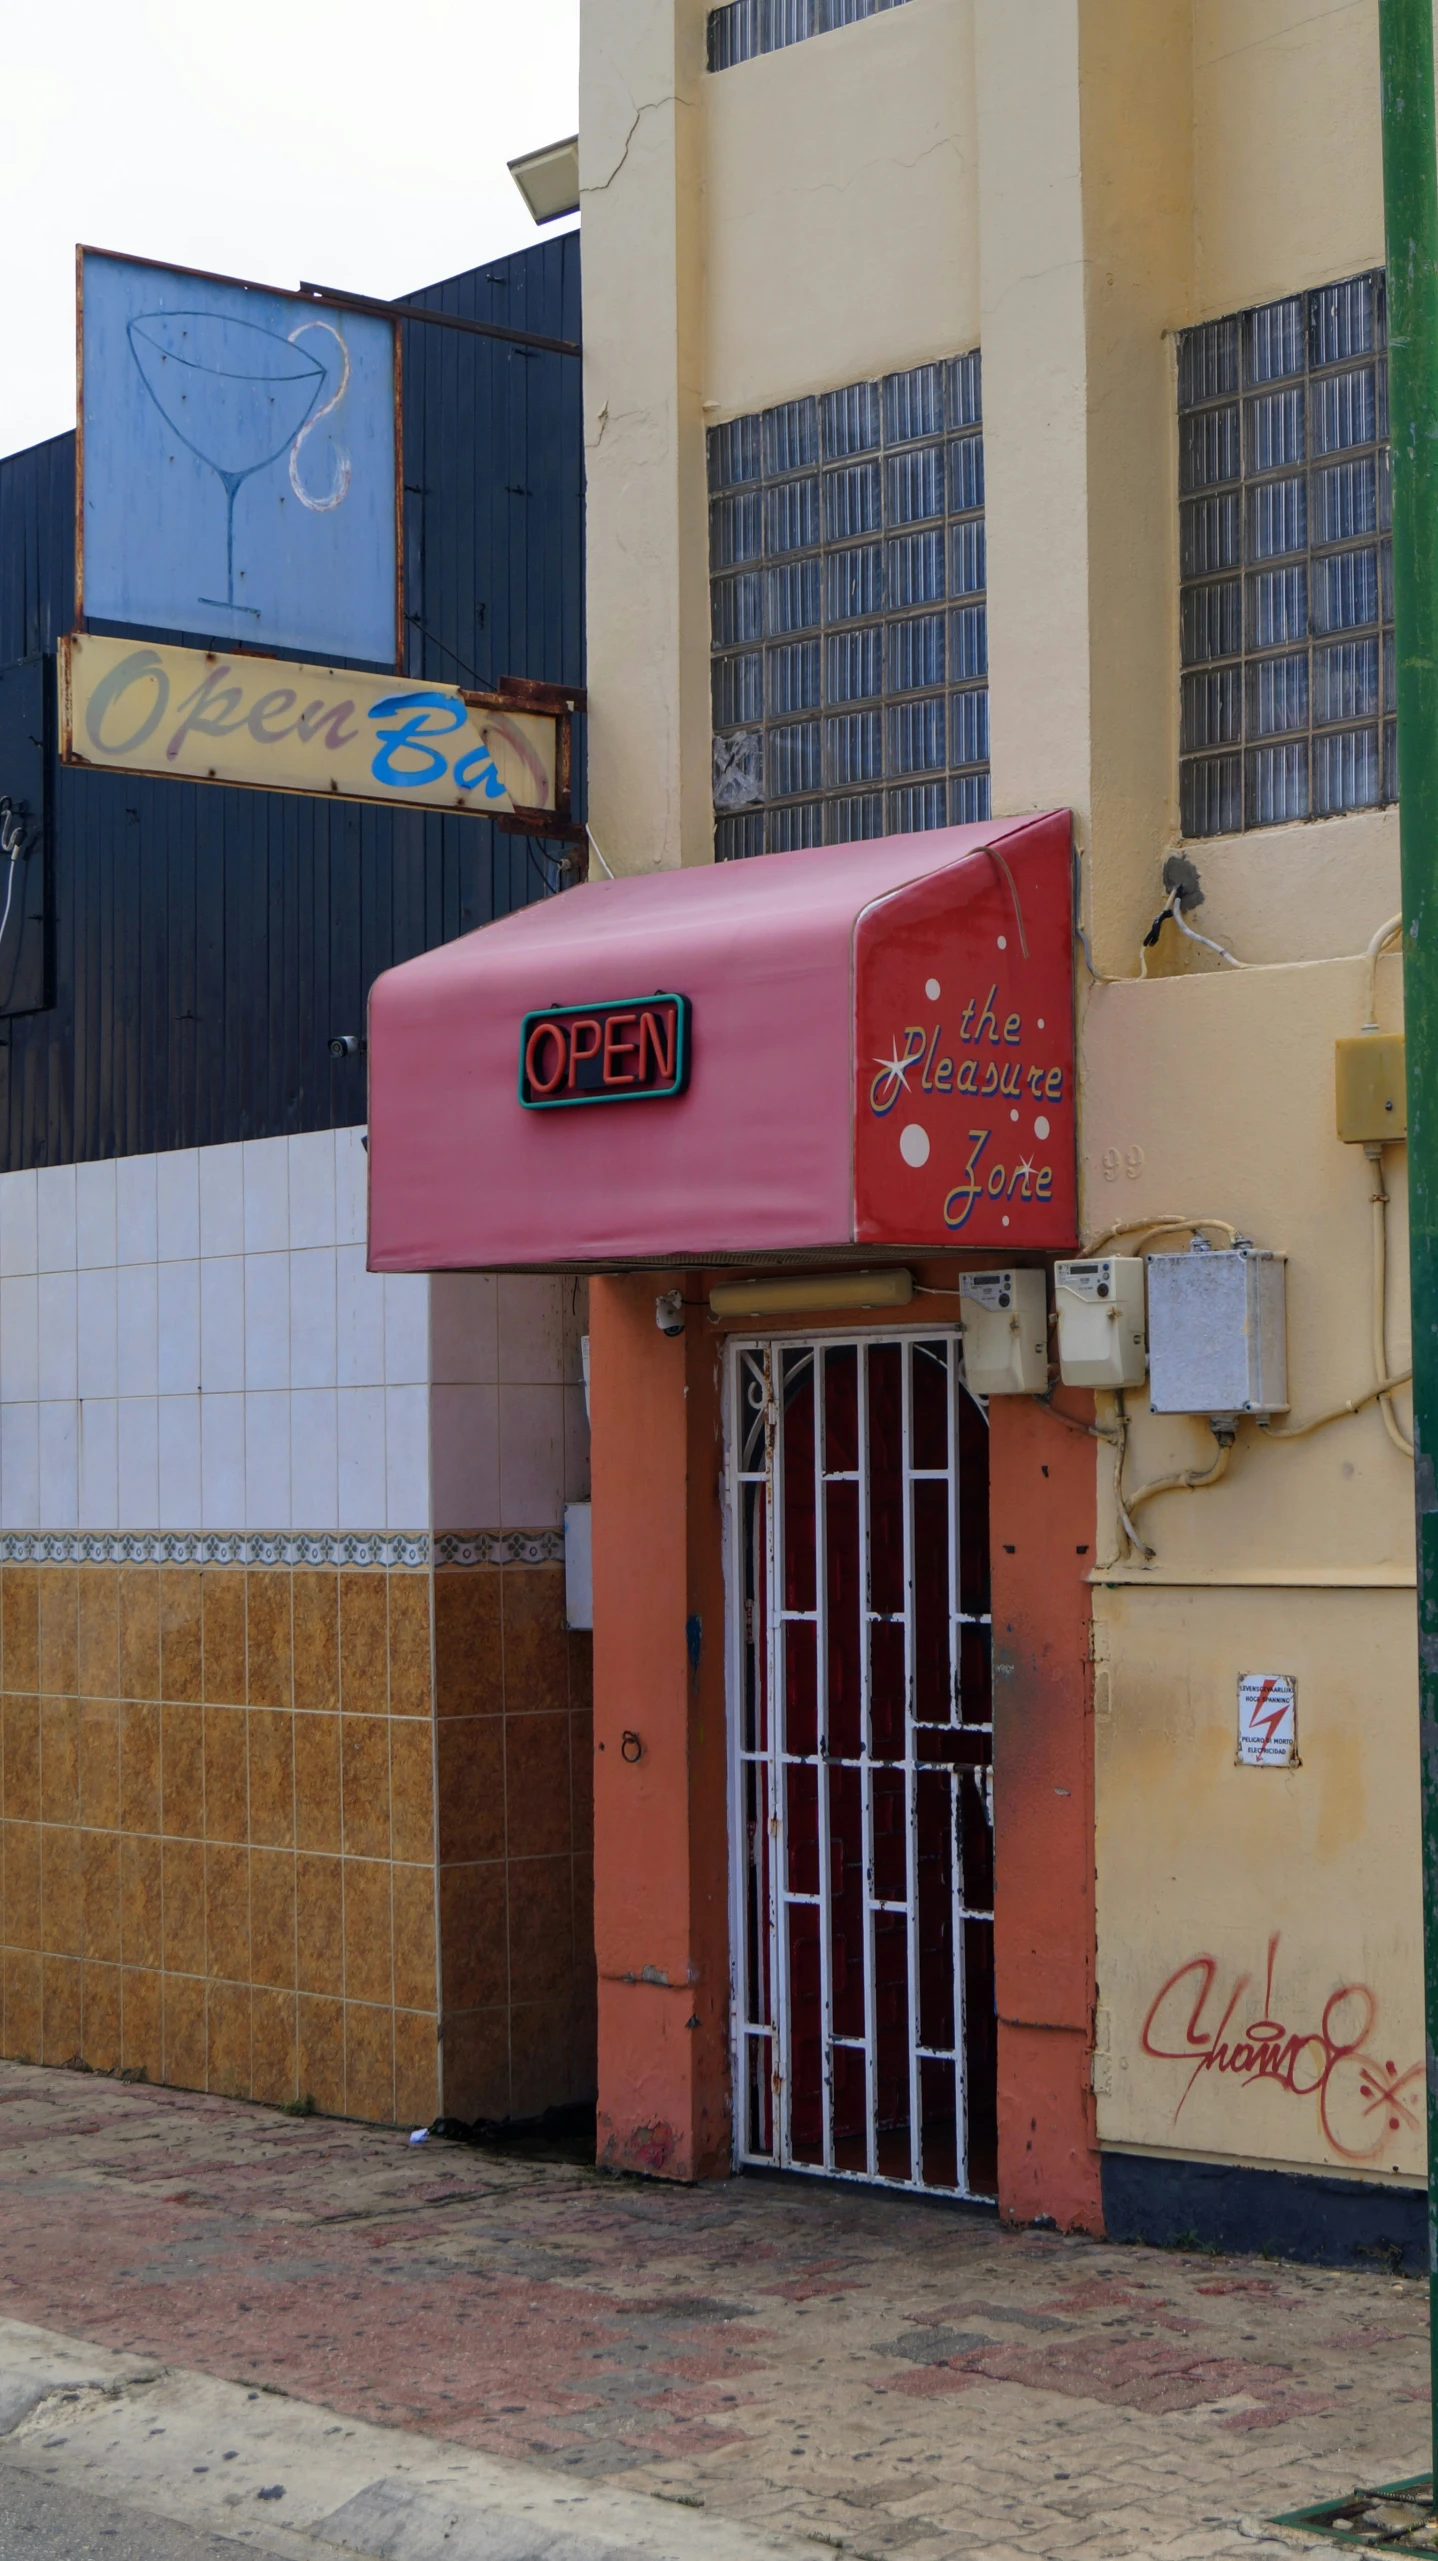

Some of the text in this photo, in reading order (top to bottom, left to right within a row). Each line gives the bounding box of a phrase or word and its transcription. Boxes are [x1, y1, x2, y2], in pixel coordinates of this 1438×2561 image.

[84, 648, 359, 763] Open
[959, 983, 1023, 1046] the
[525, 1009, 676, 1093] OPEN
[869, 1024, 1064, 1118] Pleasure
[943, 1129, 1054, 1231] Zone
[1101, 1144, 1146, 1183] 99
[1262, 1696, 1290, 1704] SPANNING
[1241, 1736, 1265, 1744] PELIGRO
[1247, 1747, 1287, 1755] ELECTRICIDAD
